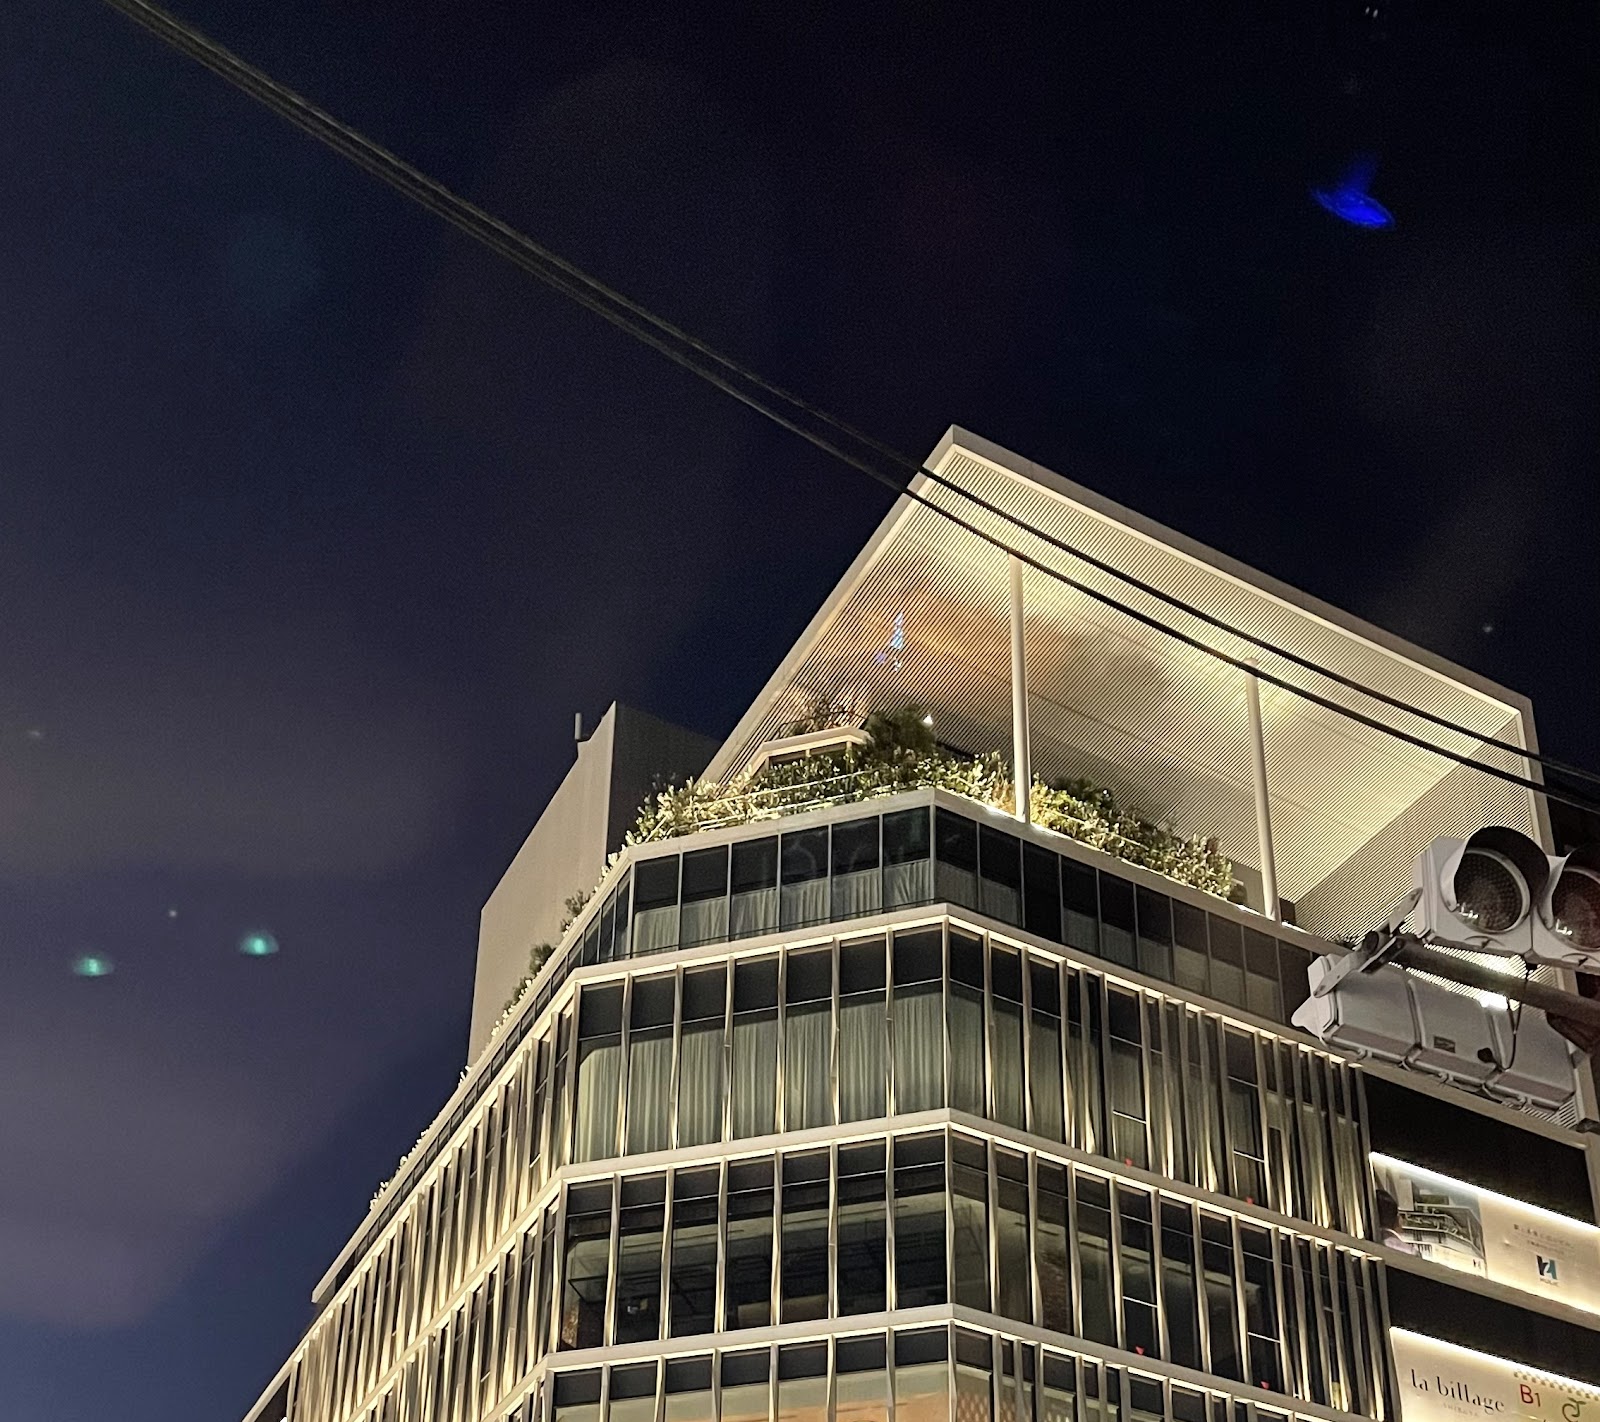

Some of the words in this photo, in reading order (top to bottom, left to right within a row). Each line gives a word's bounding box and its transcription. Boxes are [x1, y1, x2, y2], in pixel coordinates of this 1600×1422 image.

[1411, 1369, 1428, 1391] la
[1437, 1376, 1504, 1415] billage
[1520, 1384, 1541, 1407] B1
